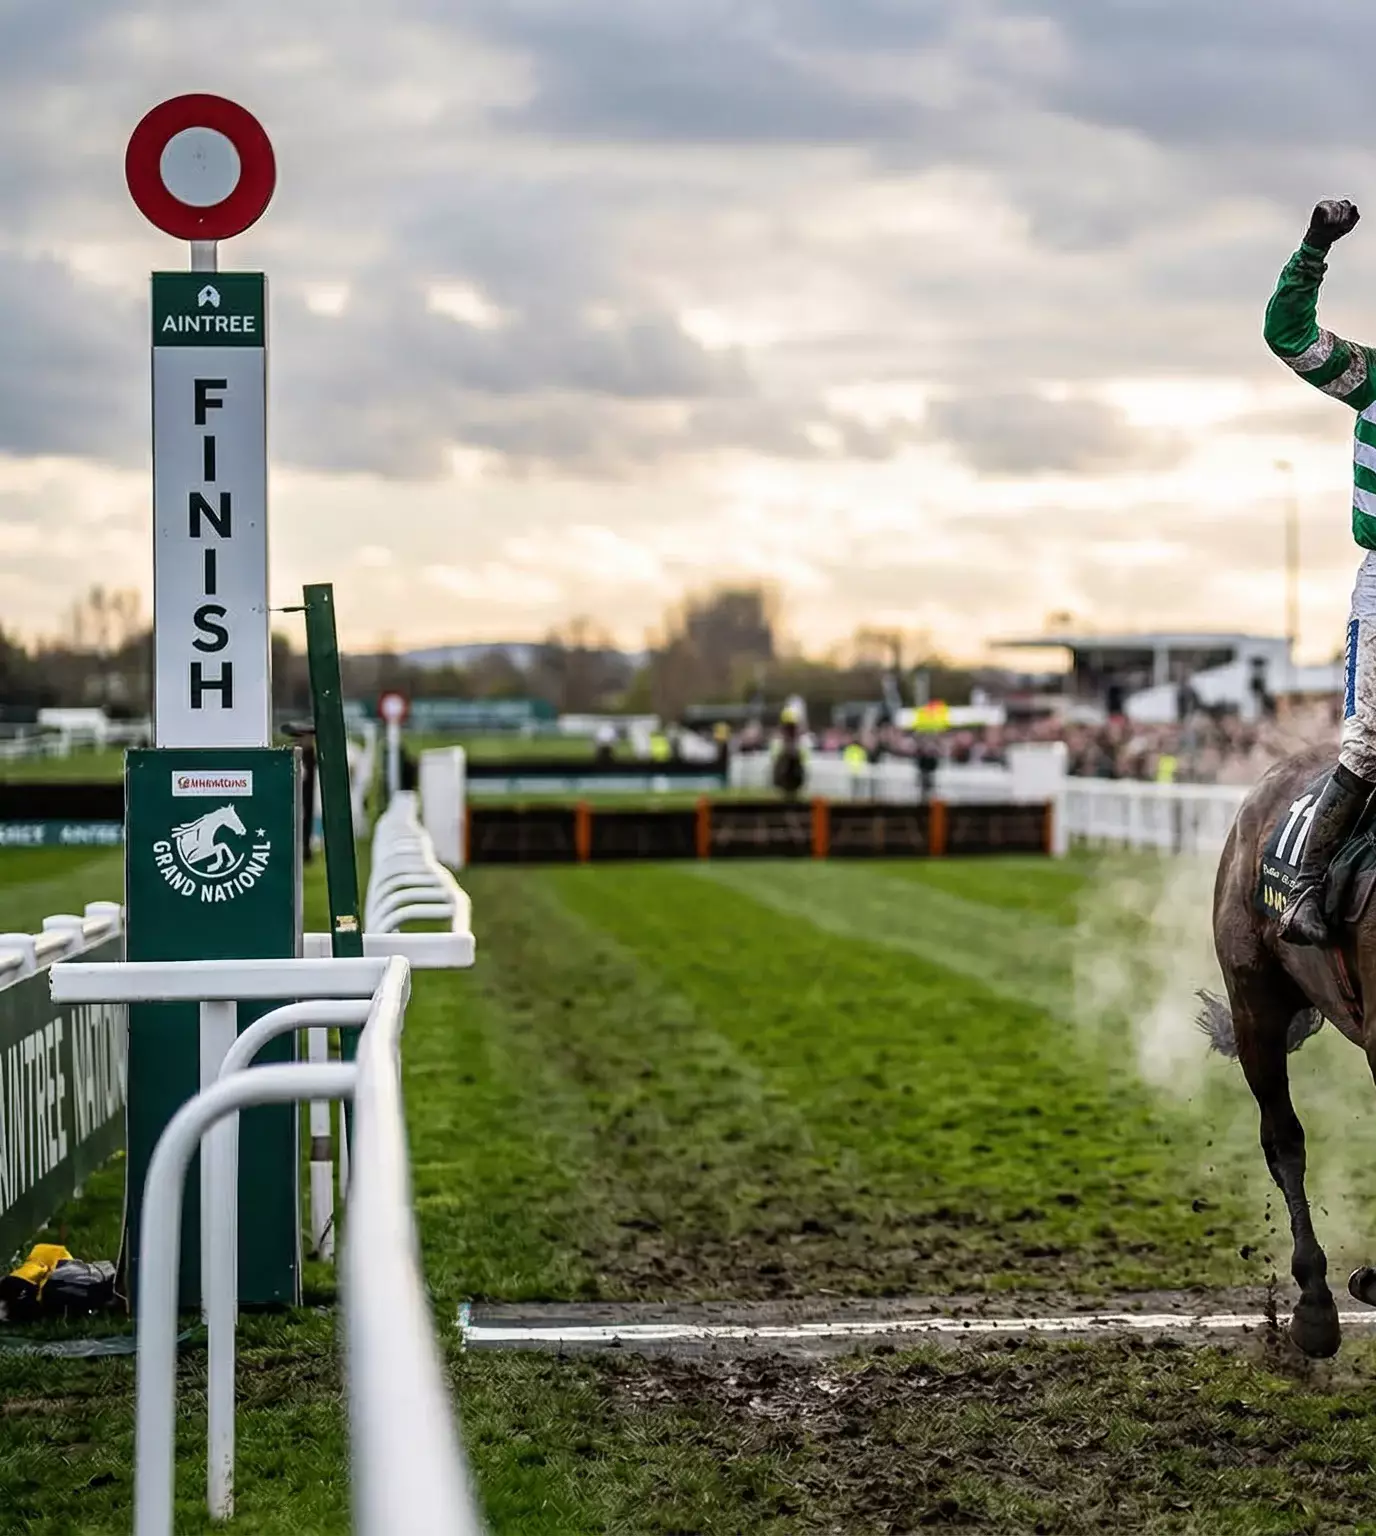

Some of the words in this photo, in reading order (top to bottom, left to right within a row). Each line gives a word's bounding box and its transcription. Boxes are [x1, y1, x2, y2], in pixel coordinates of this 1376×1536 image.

[162, 315, 255, 332] AINTREE
[189, 378, 233, 709] FINISH
[1275, 794, 1319, 867] 11
[153, 841, 196, 896] GRAND
[201, 841, 271, 902] NATIONAL
